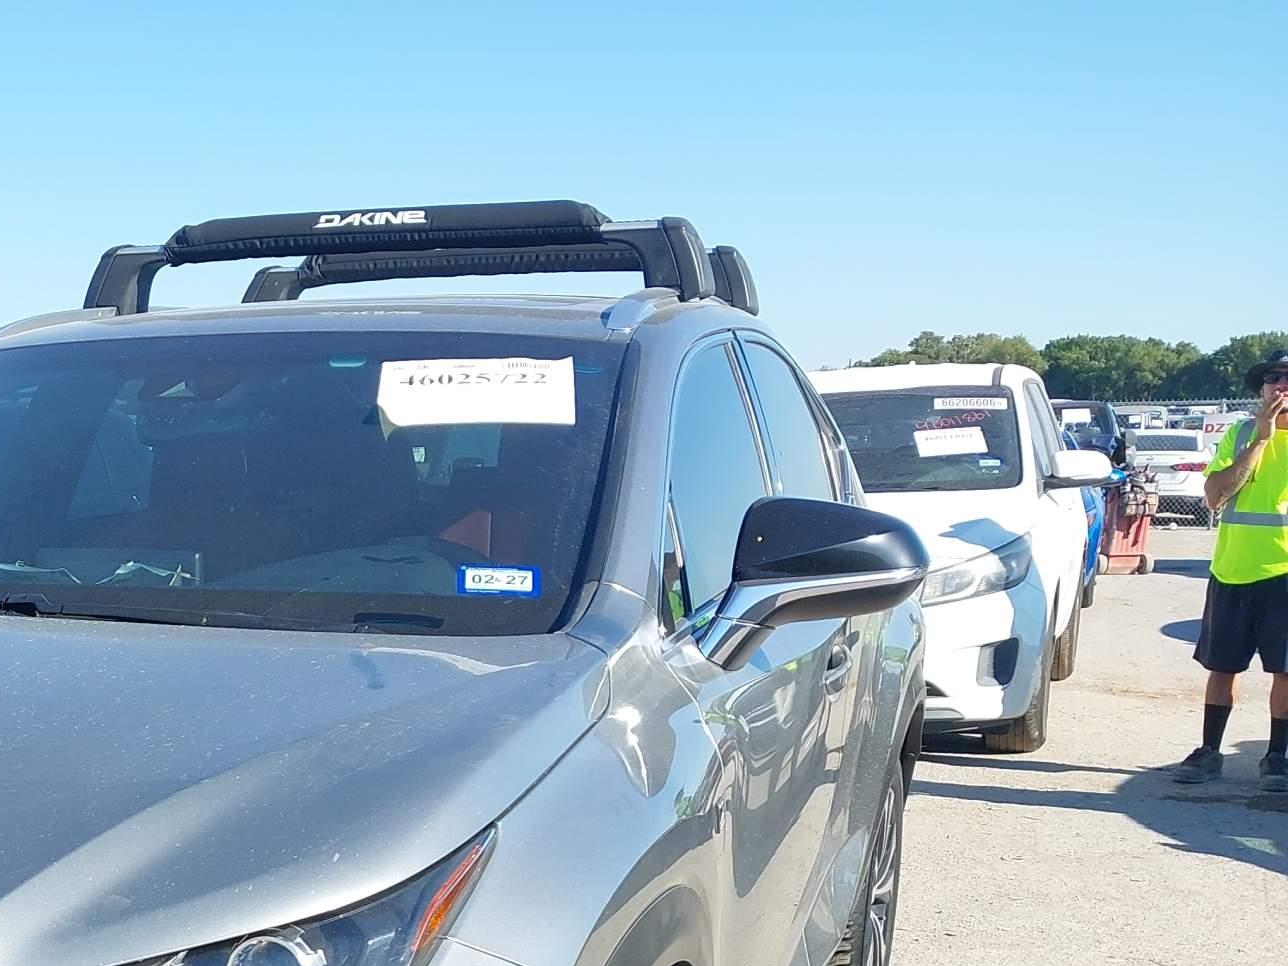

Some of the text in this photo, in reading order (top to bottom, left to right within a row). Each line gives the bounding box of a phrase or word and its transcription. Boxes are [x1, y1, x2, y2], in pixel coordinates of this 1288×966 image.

[313, 210, 428, 229] DAKINE
[399, 372, 549, 386] 46025722
[1204, 422, 1233, 433] DZ
